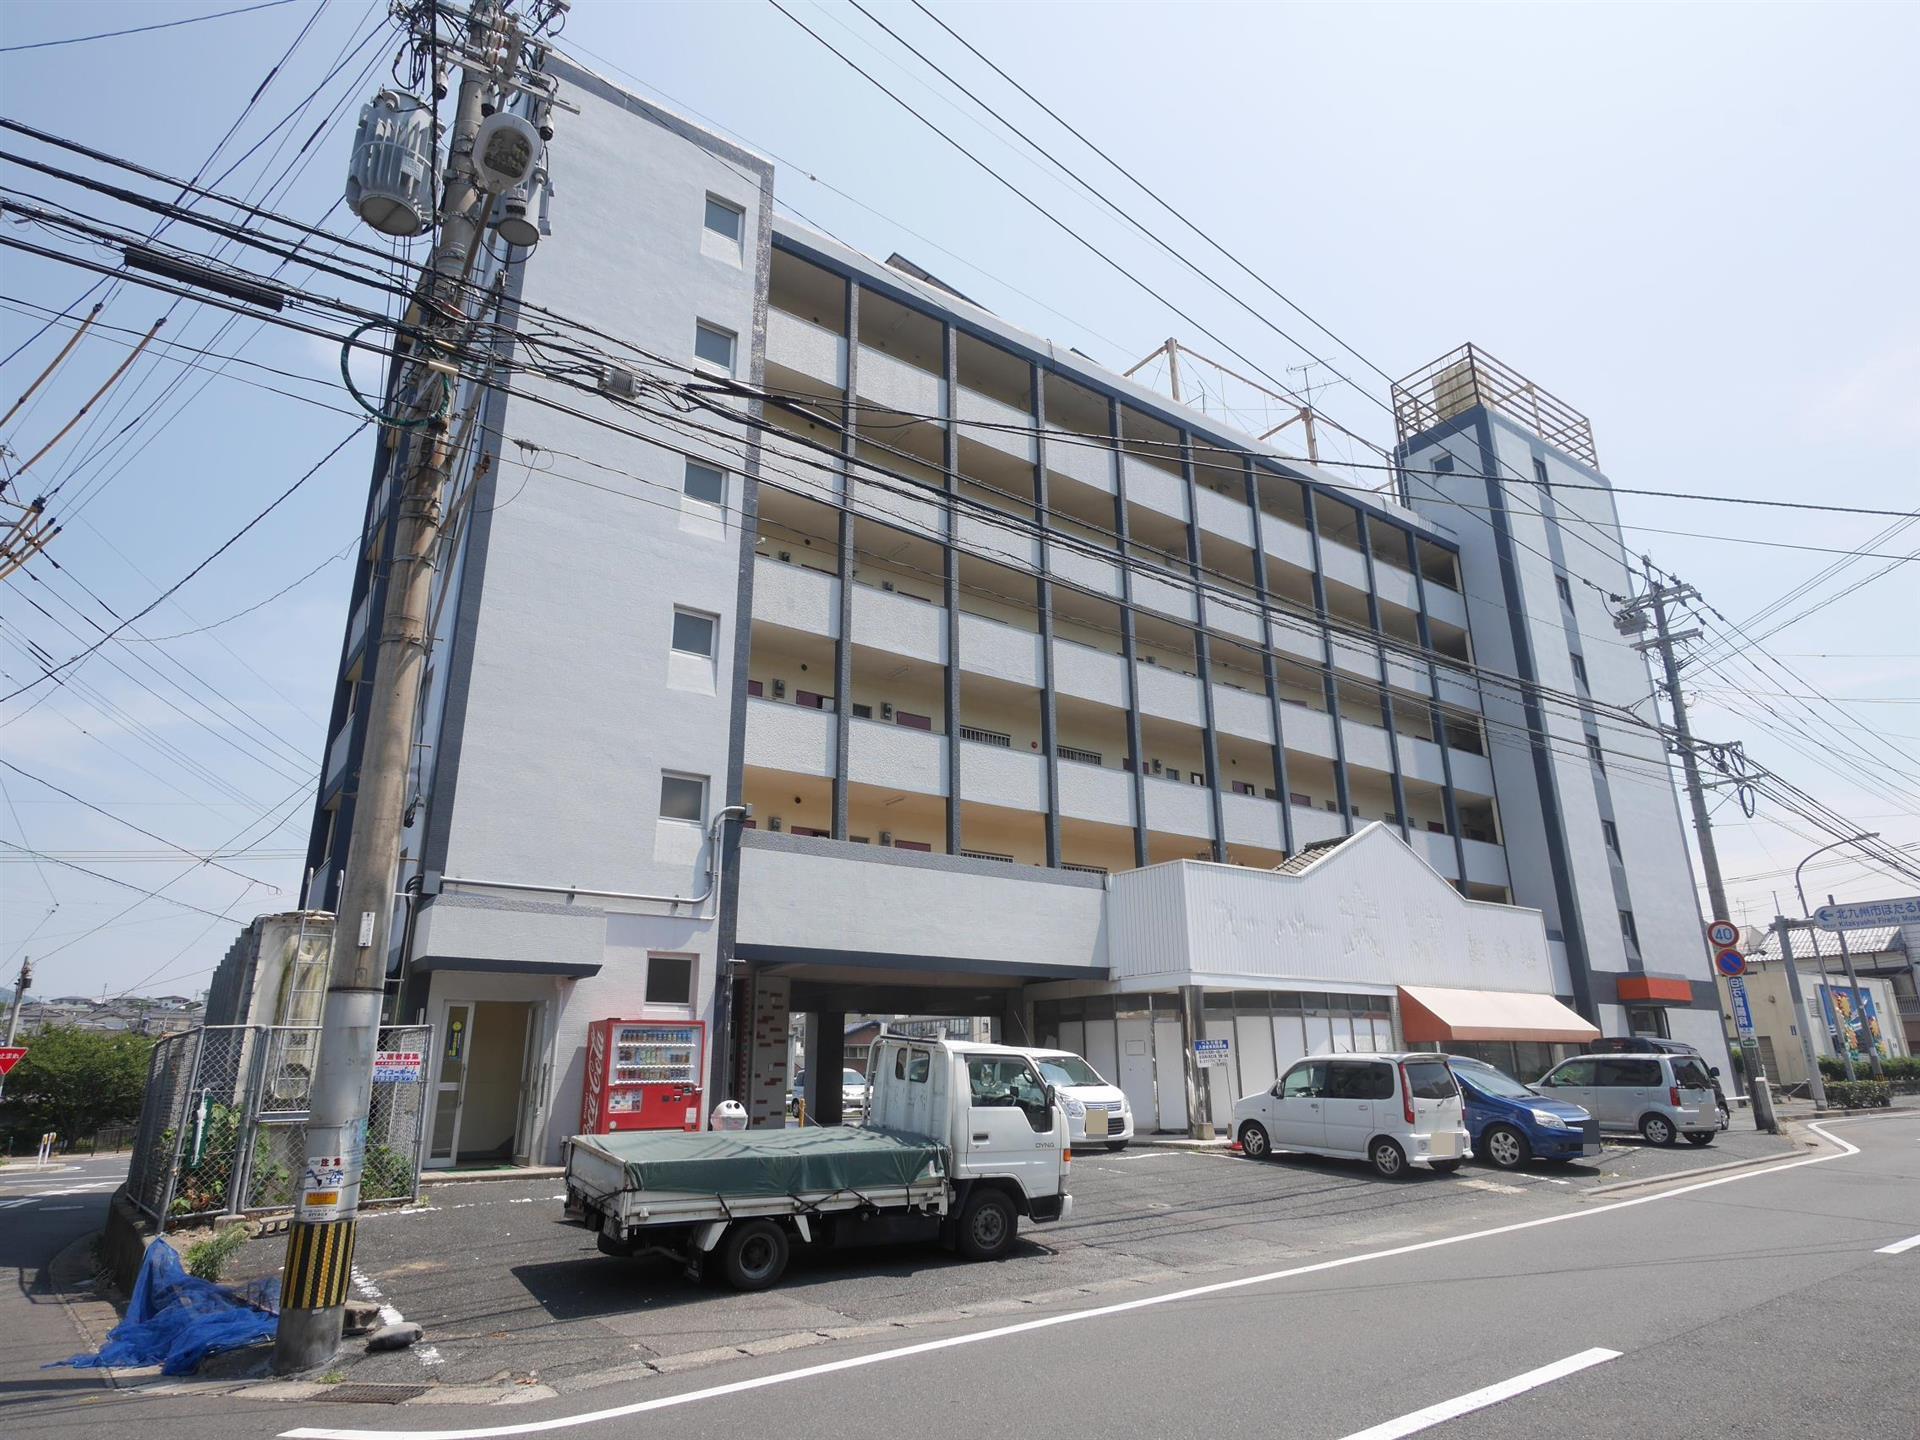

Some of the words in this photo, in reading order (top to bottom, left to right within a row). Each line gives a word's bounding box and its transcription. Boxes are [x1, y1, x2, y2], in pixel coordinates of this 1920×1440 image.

[1836, 901, 1920, 920] 北九州市ほたる
[1839, 919, 1876, 928] Kitakyushu
[1878, 916, 1900, 924] Firefly
[1716, 928, 1733, 940] 40
